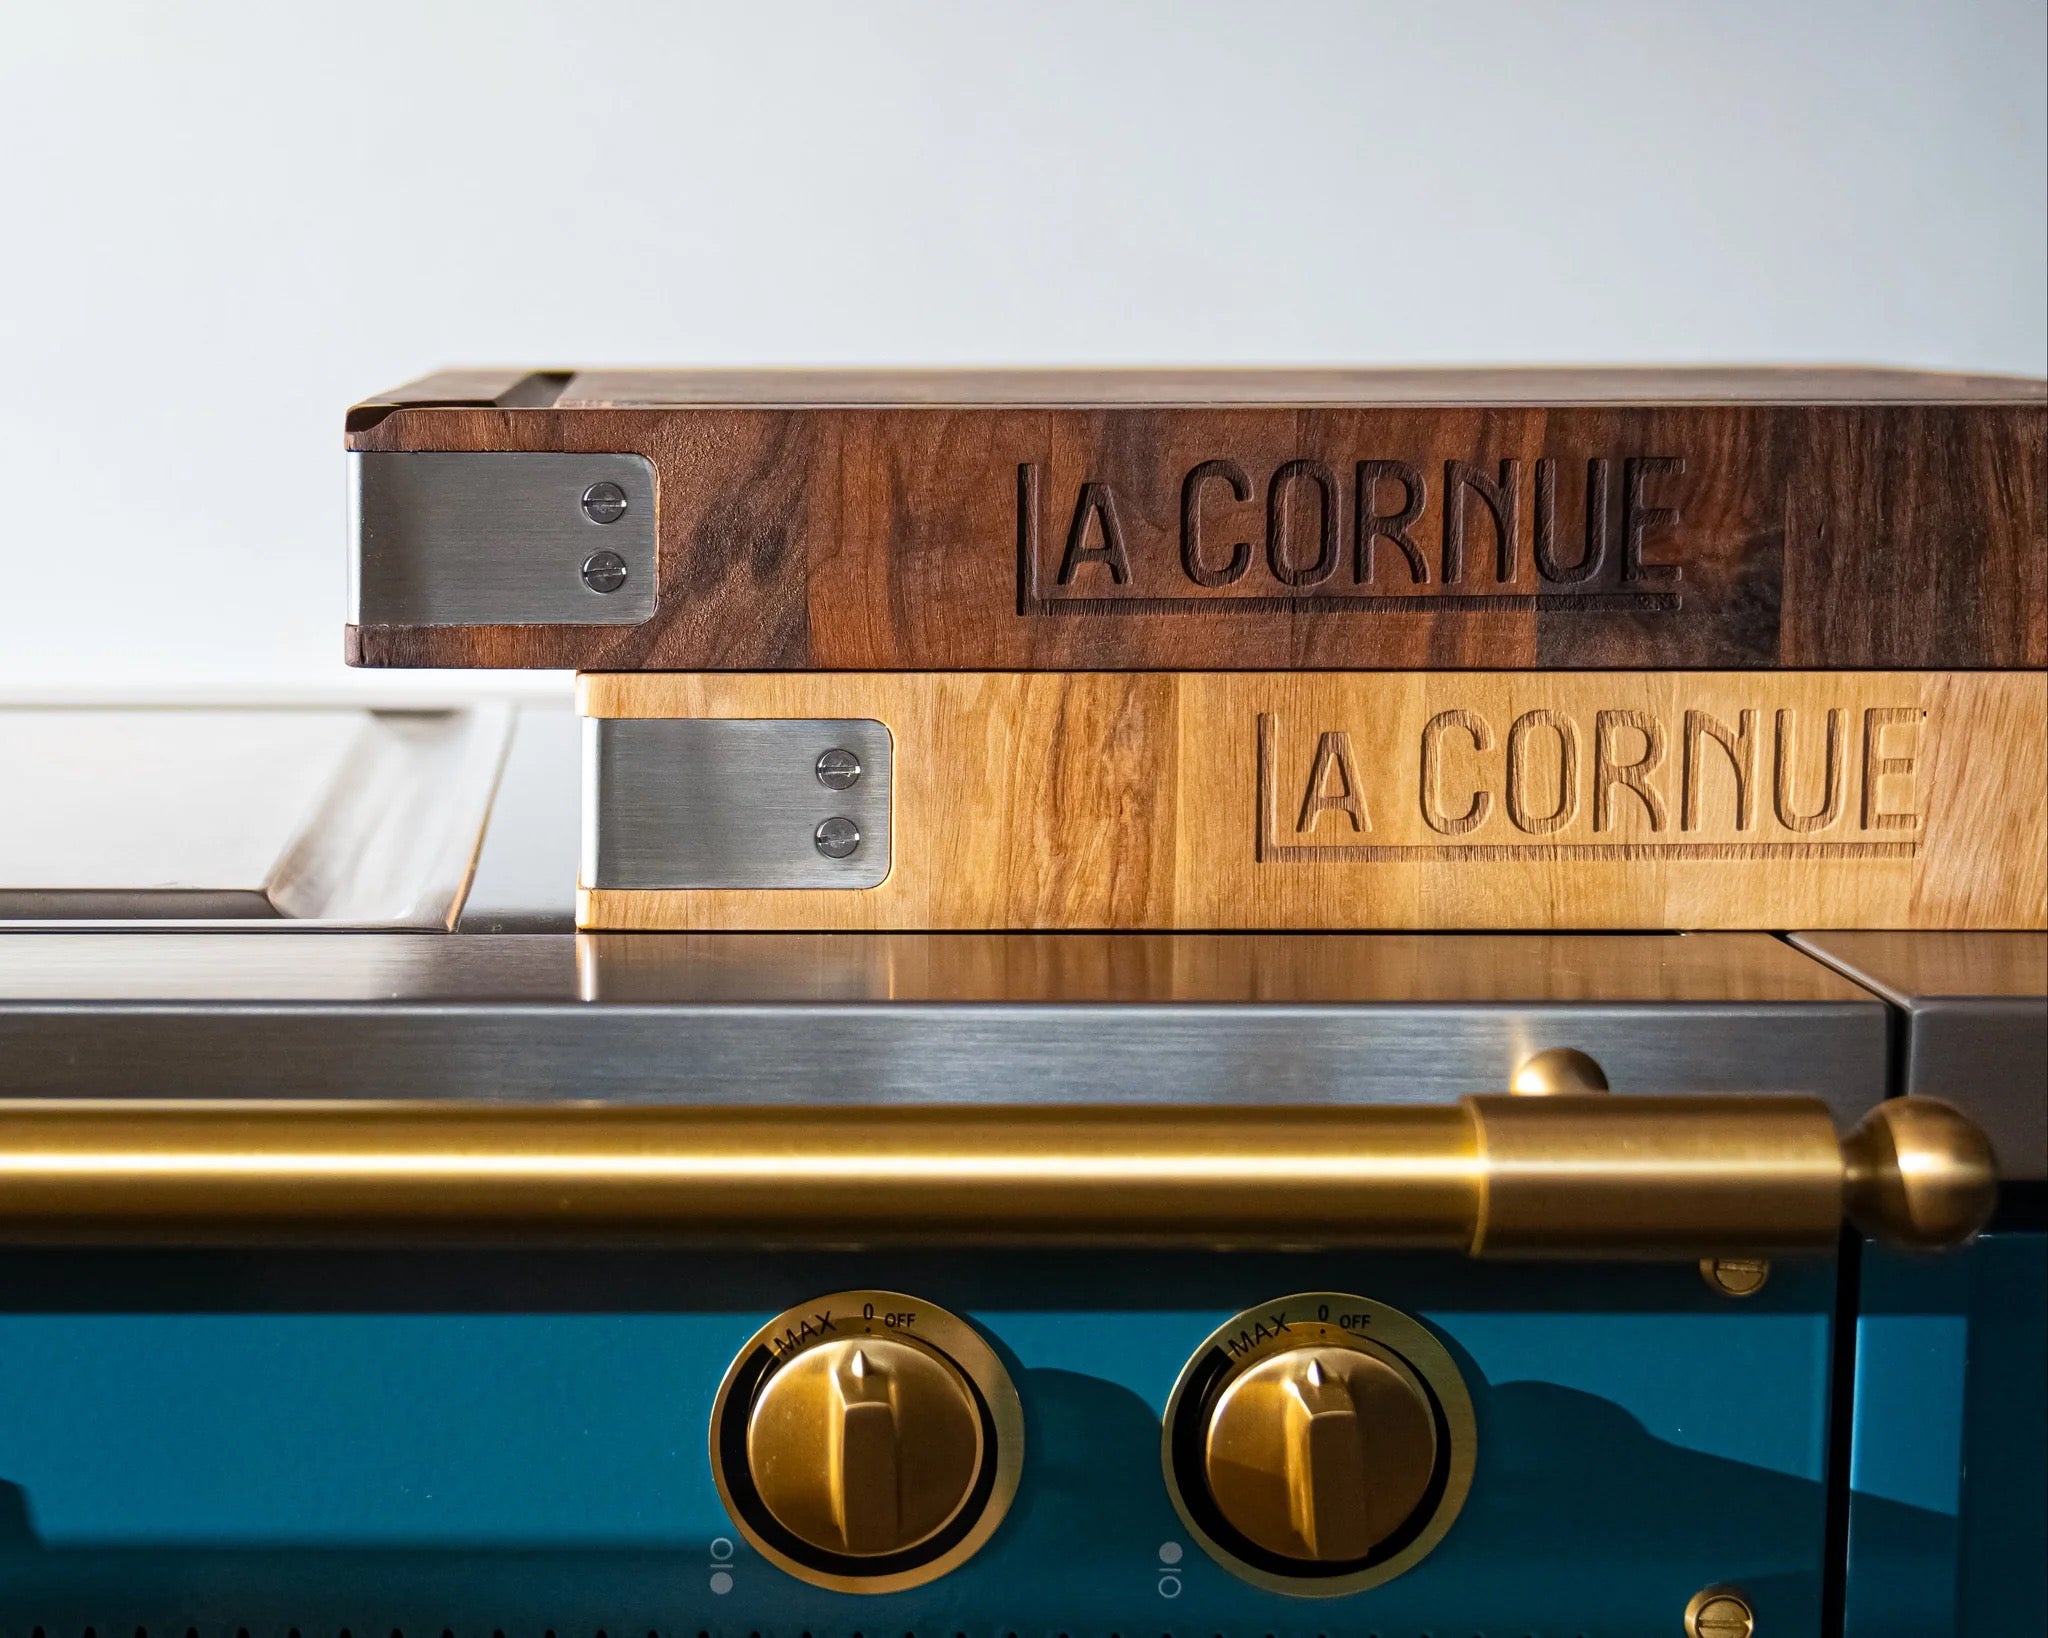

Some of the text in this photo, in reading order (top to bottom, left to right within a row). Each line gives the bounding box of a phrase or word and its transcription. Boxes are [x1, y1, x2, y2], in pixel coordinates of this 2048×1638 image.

[1017, 458, 1686, 617] LA CORNUE
[1257, 707, 1924, 863] LA CORNUE
[773, 1310, 837, 1357] MAX
[884, 1312, 916, 1328] OFF
[1227, 1311, 1291, 1358] MAX
[1339, 1314, 1371, 1330] OFF
